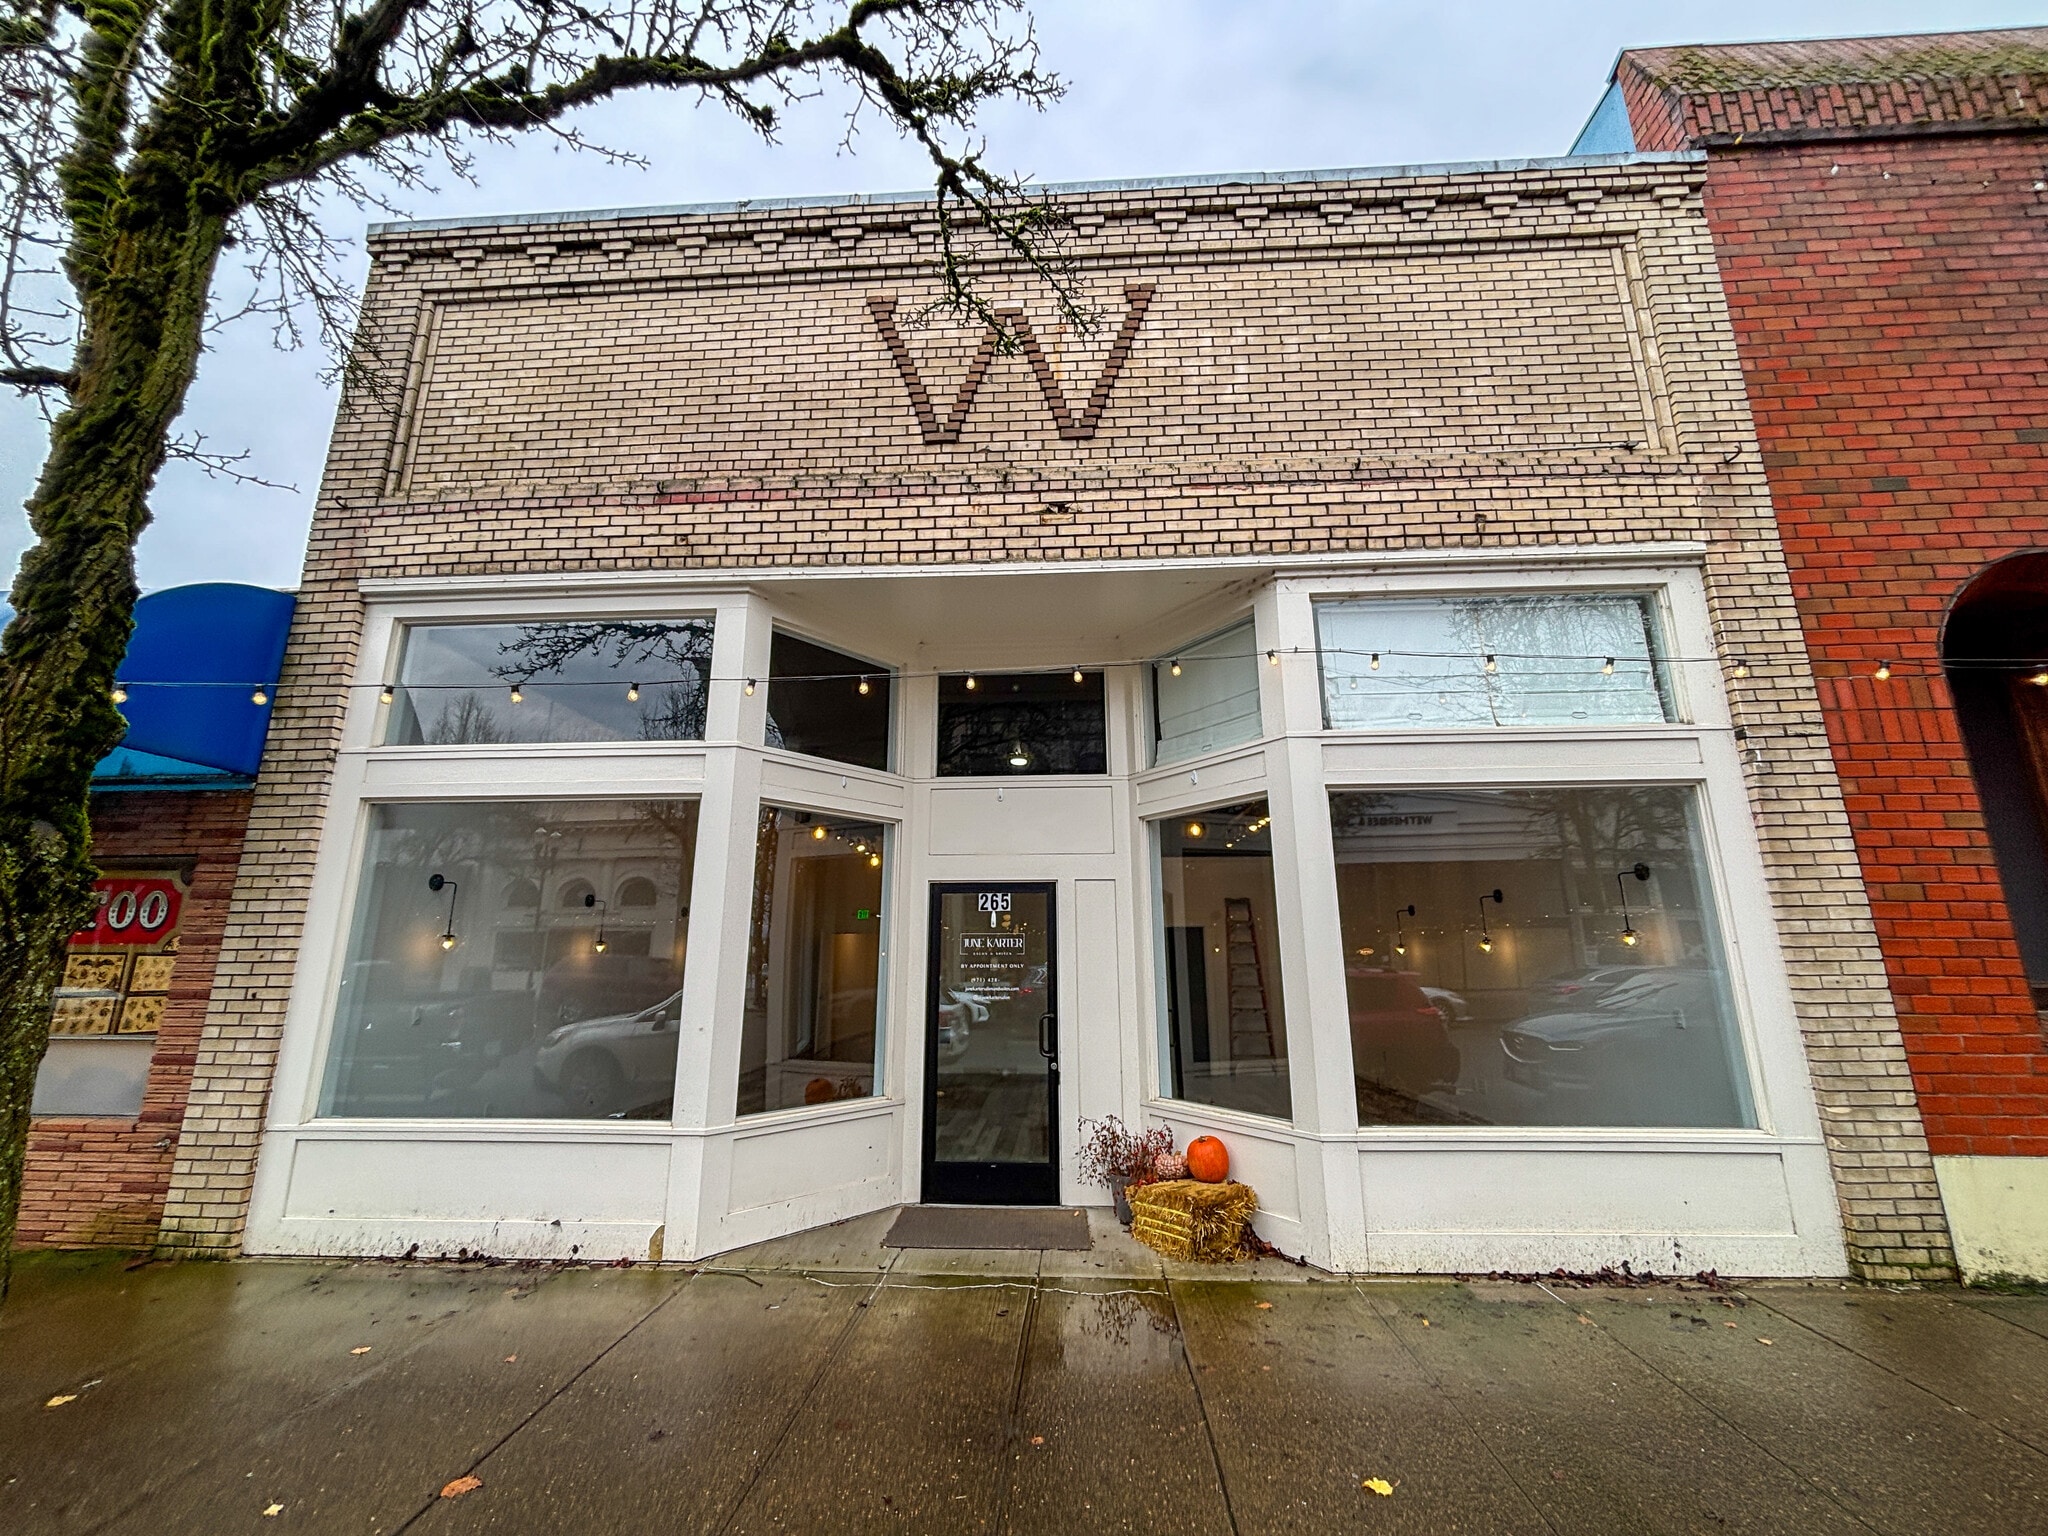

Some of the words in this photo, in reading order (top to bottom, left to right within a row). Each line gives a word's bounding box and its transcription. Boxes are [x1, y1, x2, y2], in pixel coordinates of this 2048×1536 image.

[866, 283, 1156, 445] W
[980, 893, 1010, 910] 265
[964, 938, 984, 948] JUNE
[986, 938, 1023, 948] KARTER
